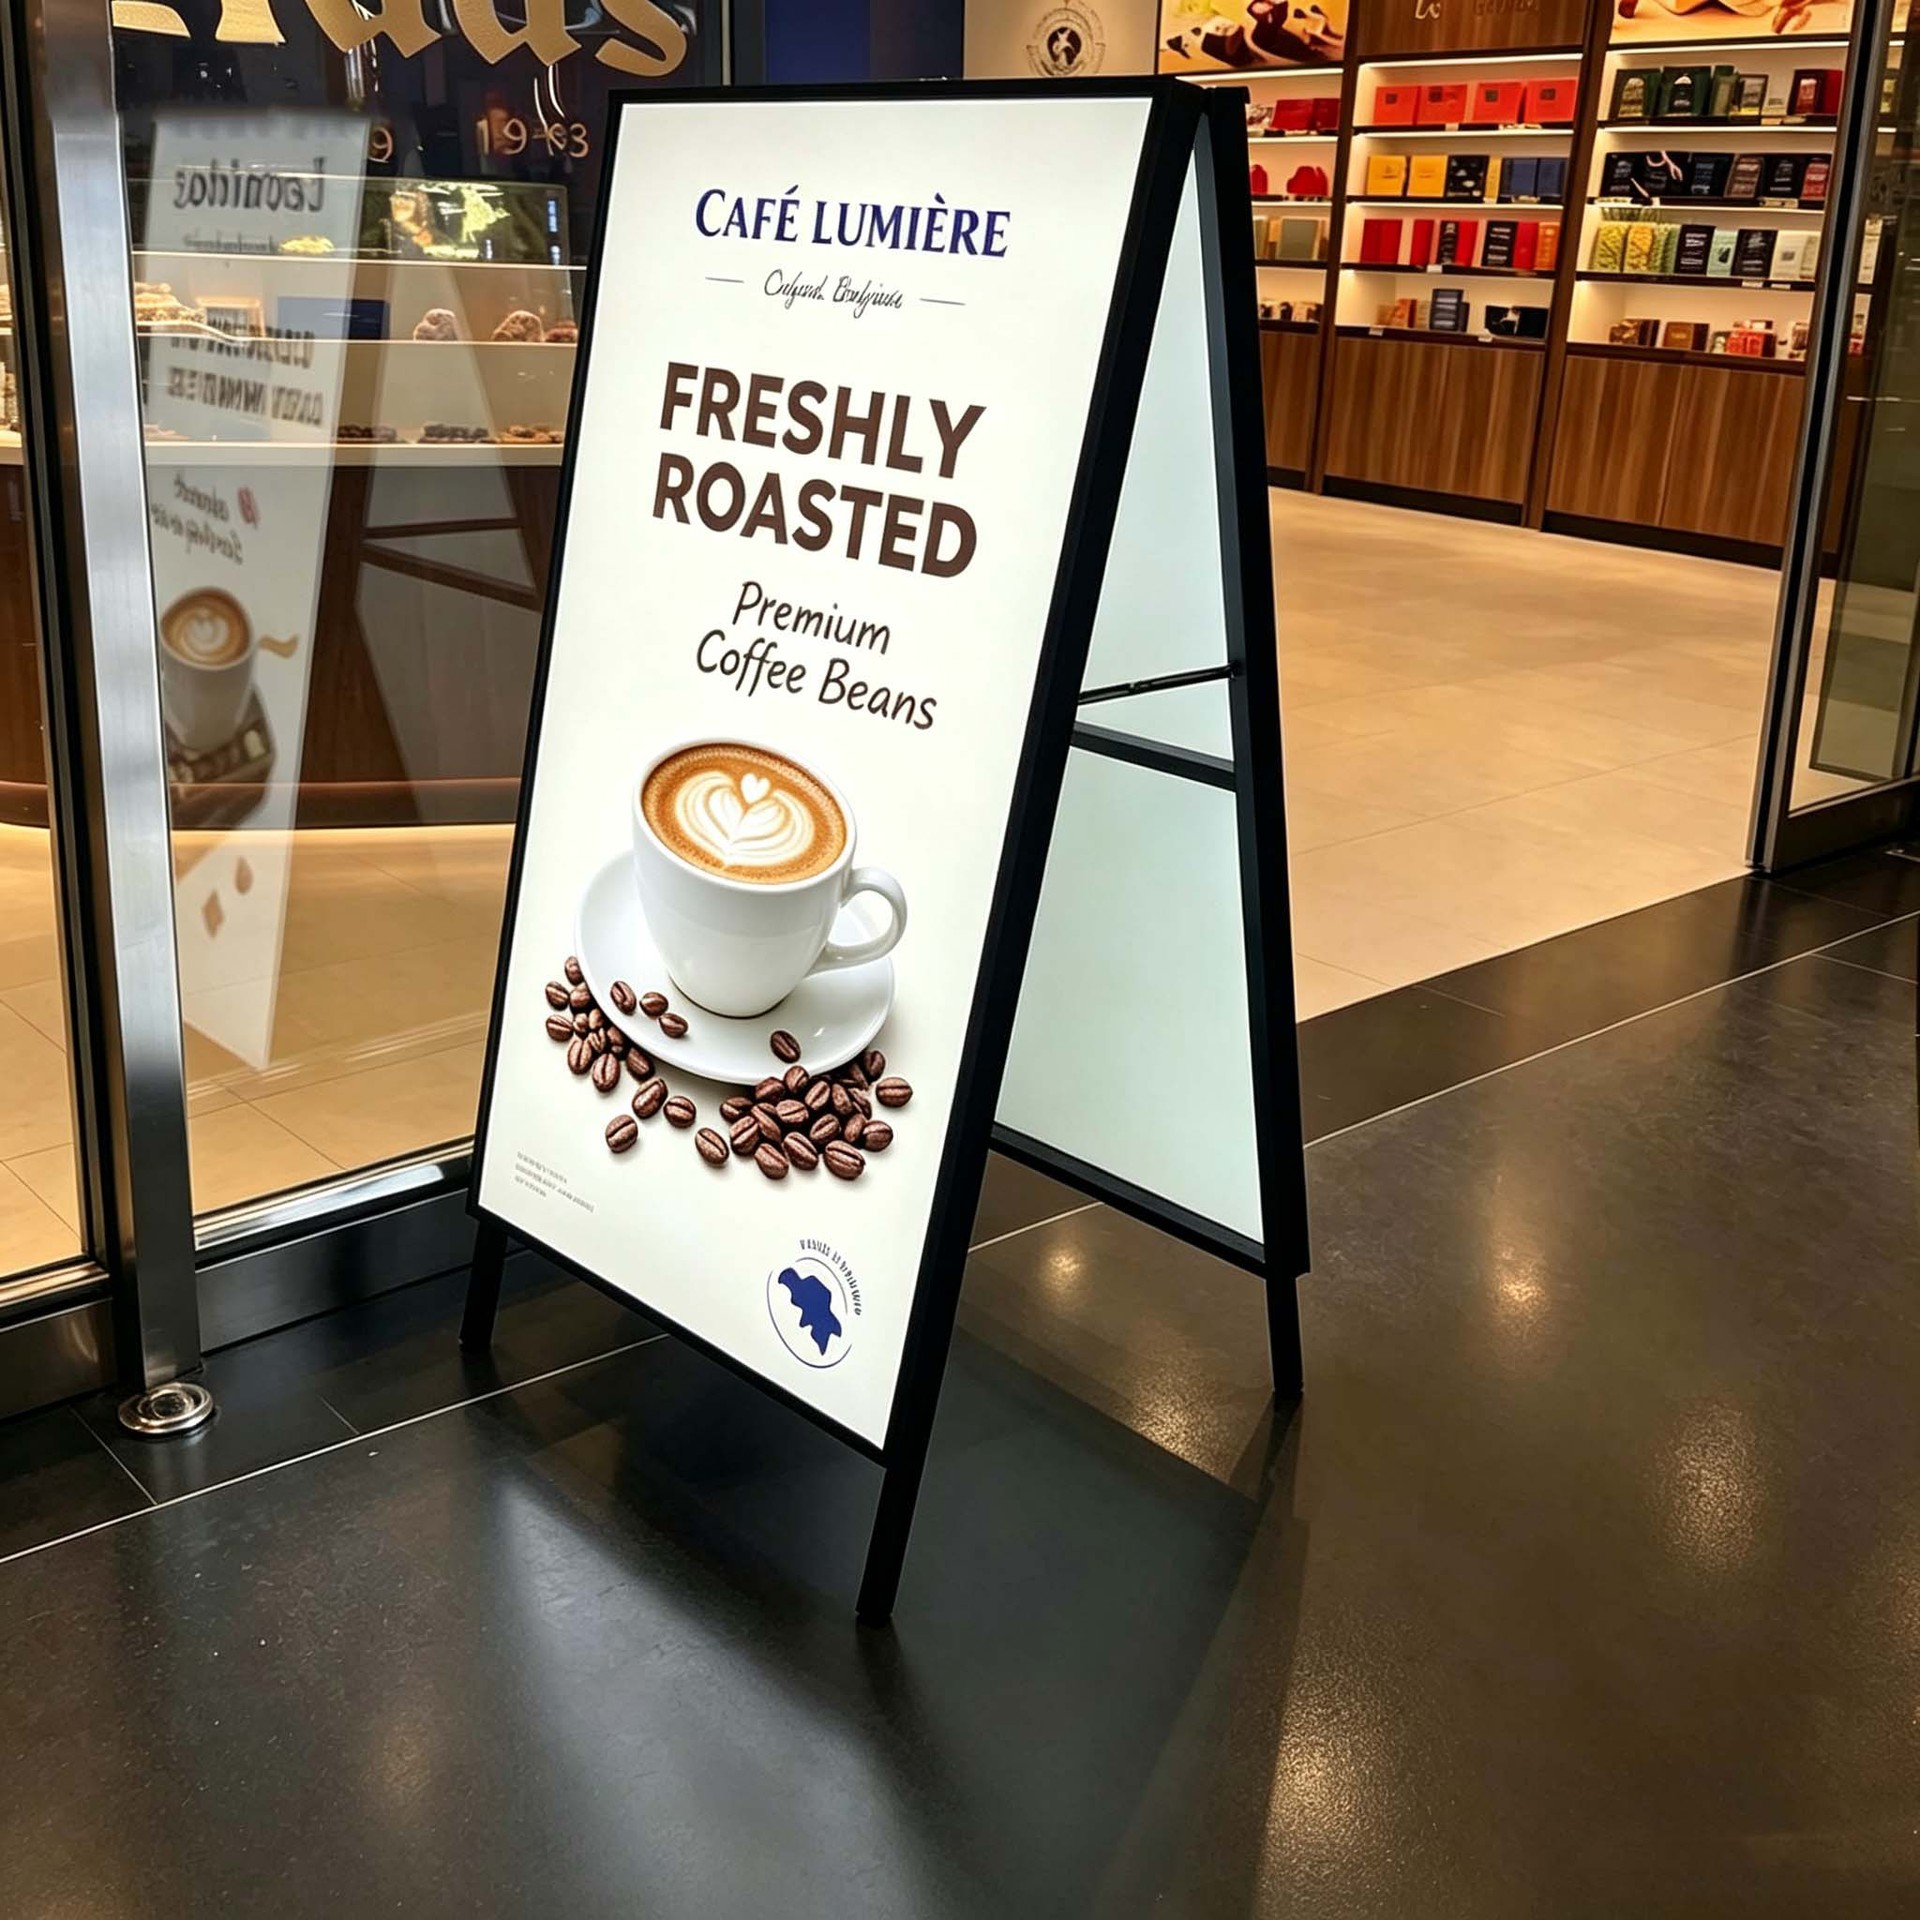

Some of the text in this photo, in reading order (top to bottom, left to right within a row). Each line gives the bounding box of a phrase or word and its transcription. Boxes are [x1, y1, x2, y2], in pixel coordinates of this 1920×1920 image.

[695, 184, 1011, 258] CAFÉ LUMIÈRE
[659, 361, 987, 479] FRESHLY
[652, 452, 977, 578] ROASTED
[732, 581, 890, 655] Premium
[696, 629, 938, 730] Coffee Beans
